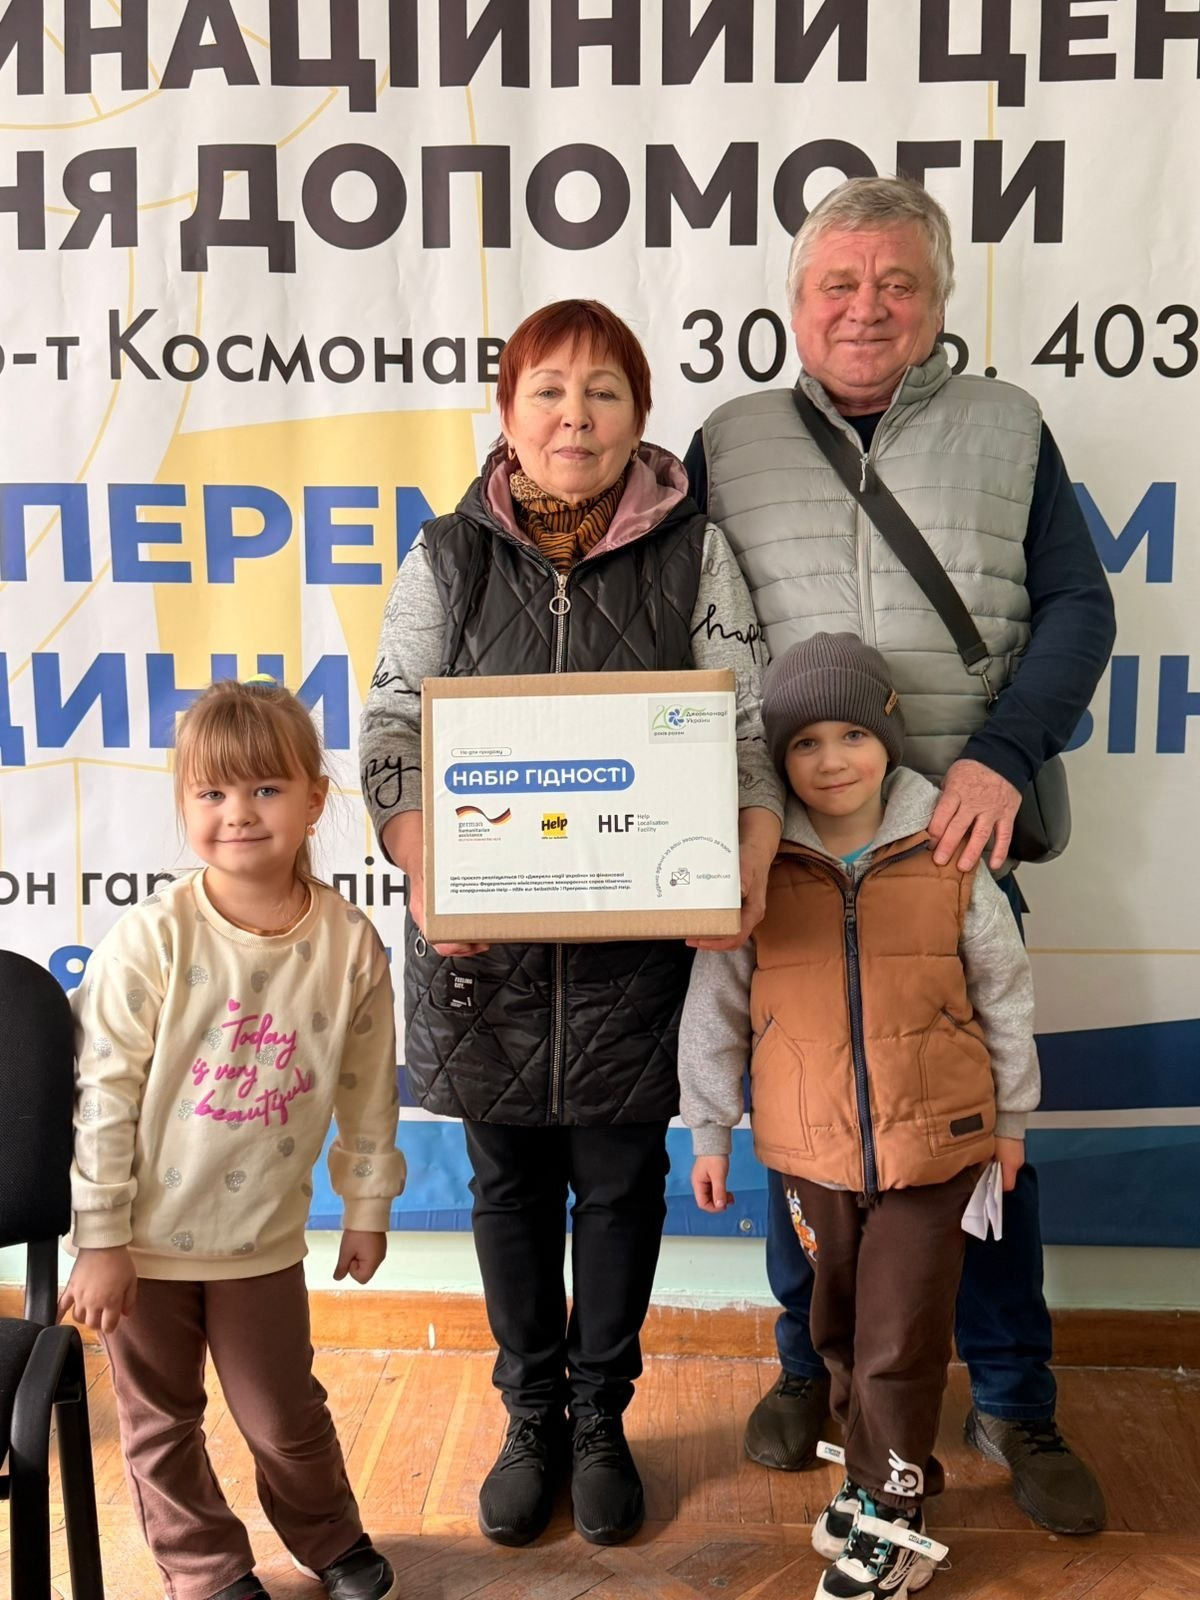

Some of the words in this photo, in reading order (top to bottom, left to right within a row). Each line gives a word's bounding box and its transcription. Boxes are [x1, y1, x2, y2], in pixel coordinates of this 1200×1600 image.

[180, 139, 1065, 273] ДОПОМОГИ
[1031, 302, 1200, 378] 403
[452, 769, 519, 787] НАБІР
[525, 766, 627, 787] ГІДНОСТІ
[541, 816, 568, 832] Help
[598, 814, 635, 833] HLF
[221, 1012, 297, 1070] Today
[192, 1058, 210, 1086] is
[214, 1064, 258, 1098] very
